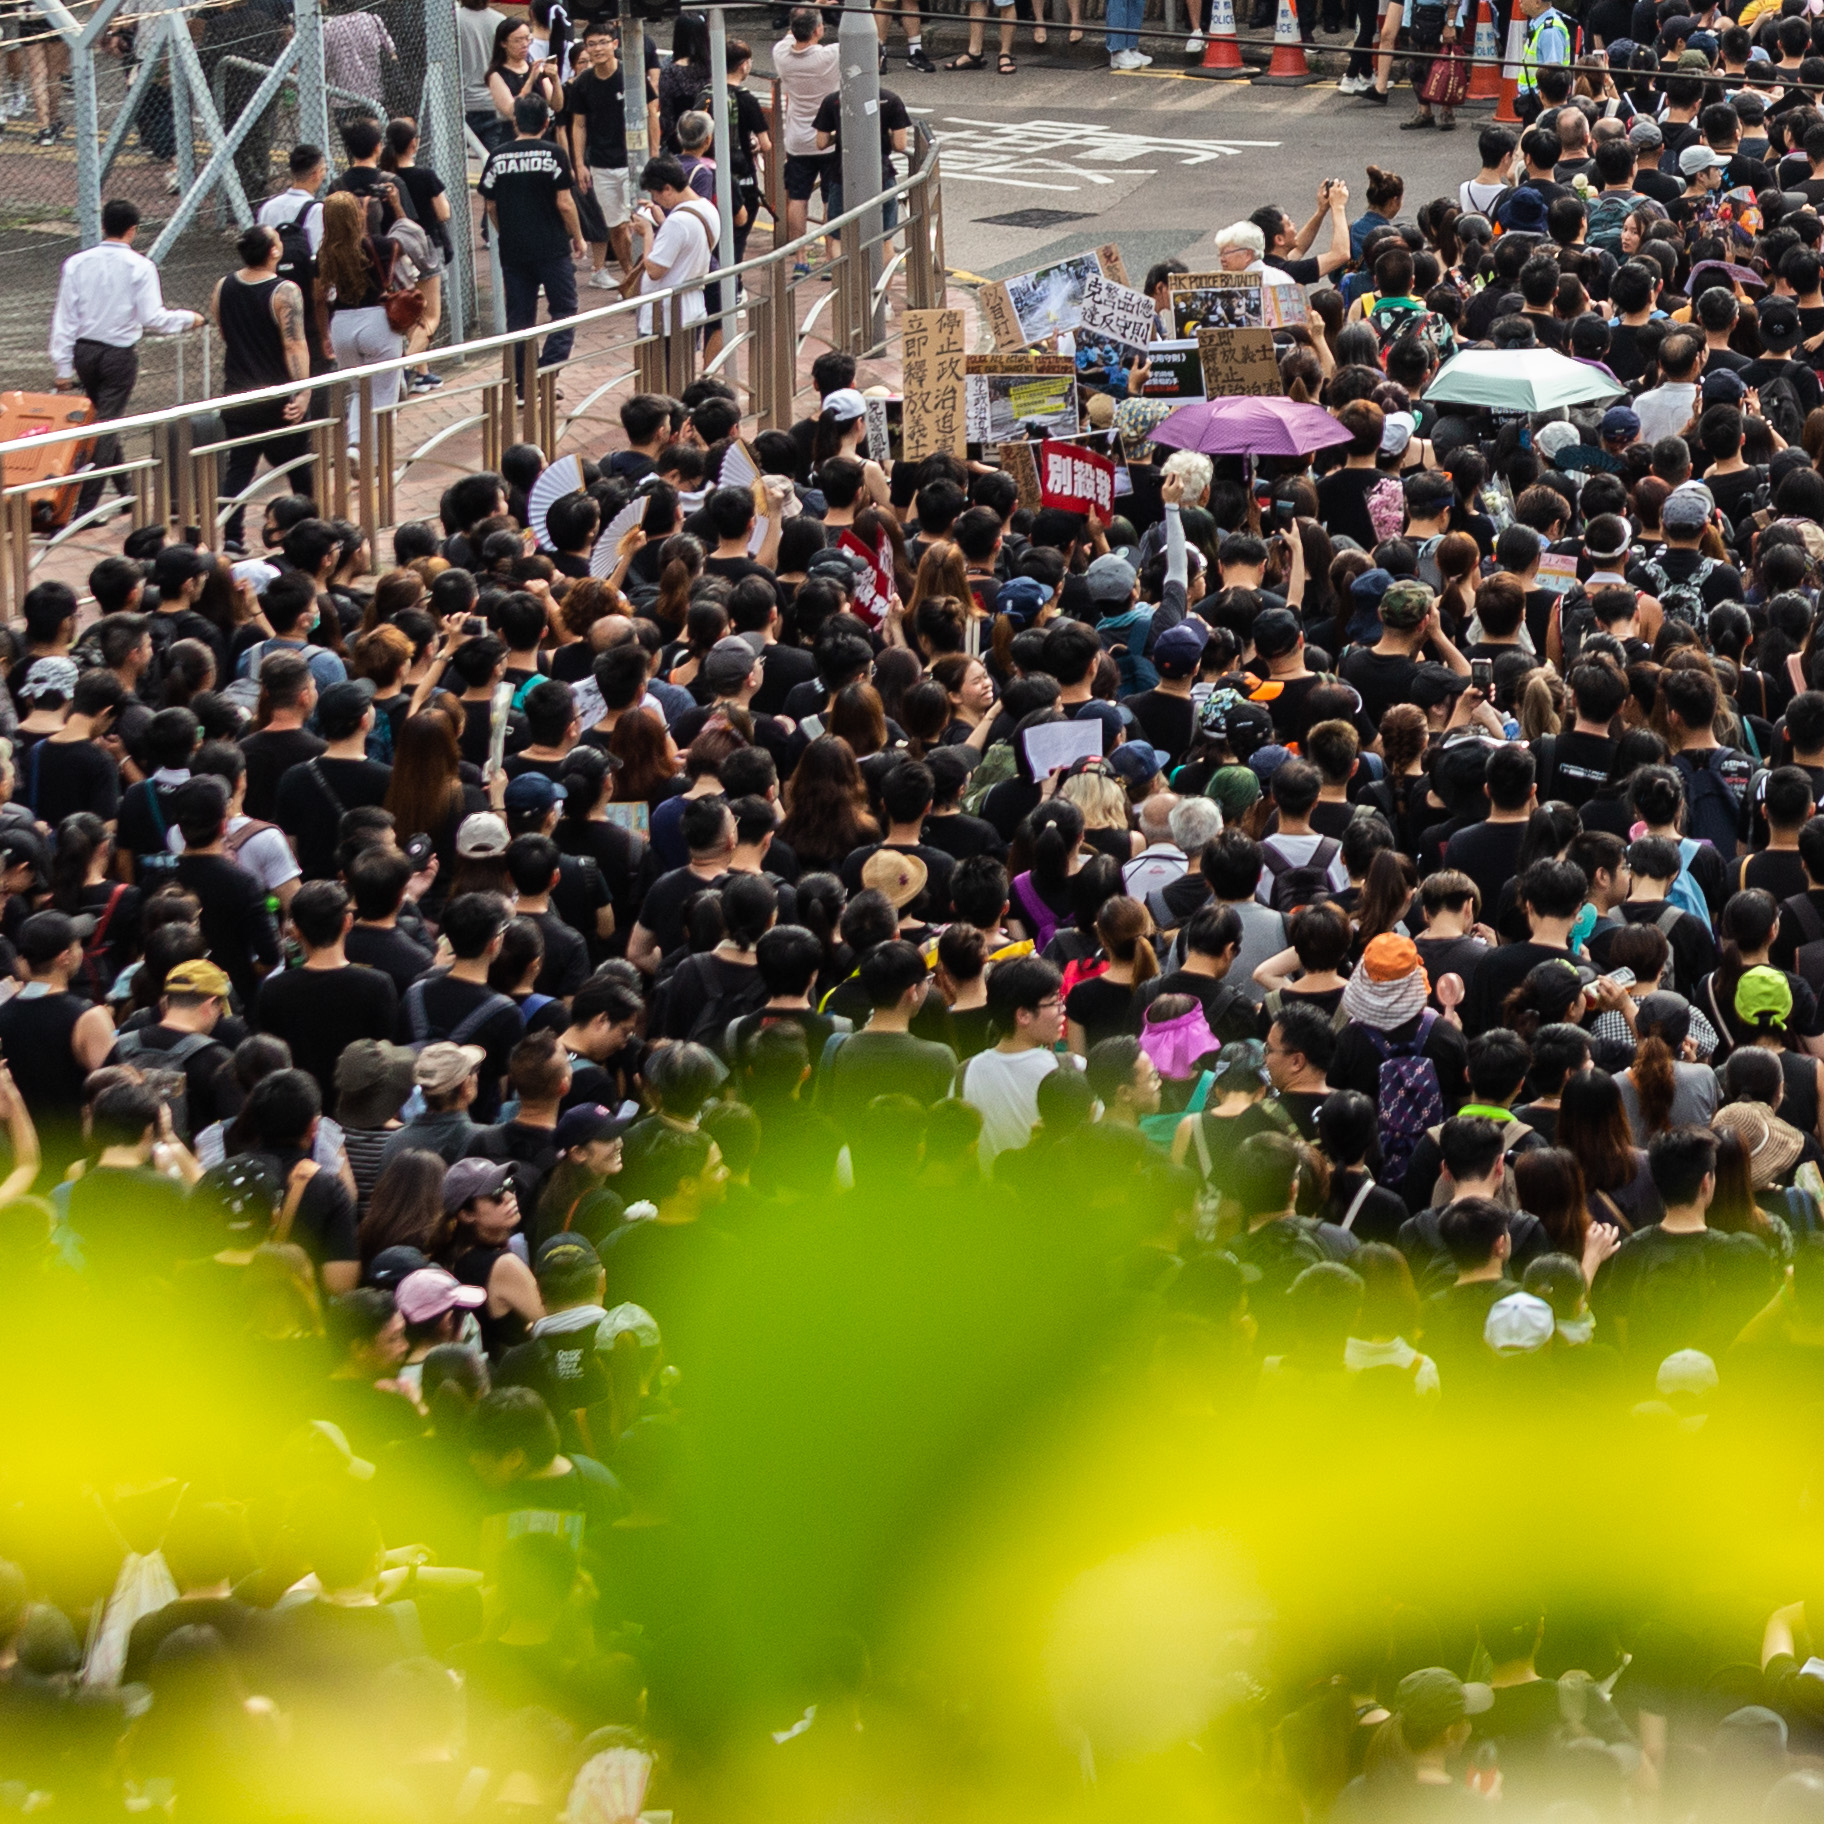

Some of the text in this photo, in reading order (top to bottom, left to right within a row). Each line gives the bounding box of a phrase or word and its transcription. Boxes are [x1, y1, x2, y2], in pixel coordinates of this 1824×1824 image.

[1171, 273, 1262, 290] HK POLICE BRUTALITY
[1080, 307, 1149, 347] 違反守則
[904, 314, 934, 462] 立即釋放義士
[935, 310, 967, 458] 停止政治迫害
[1047, 453, 1111, 511] 別殺我
